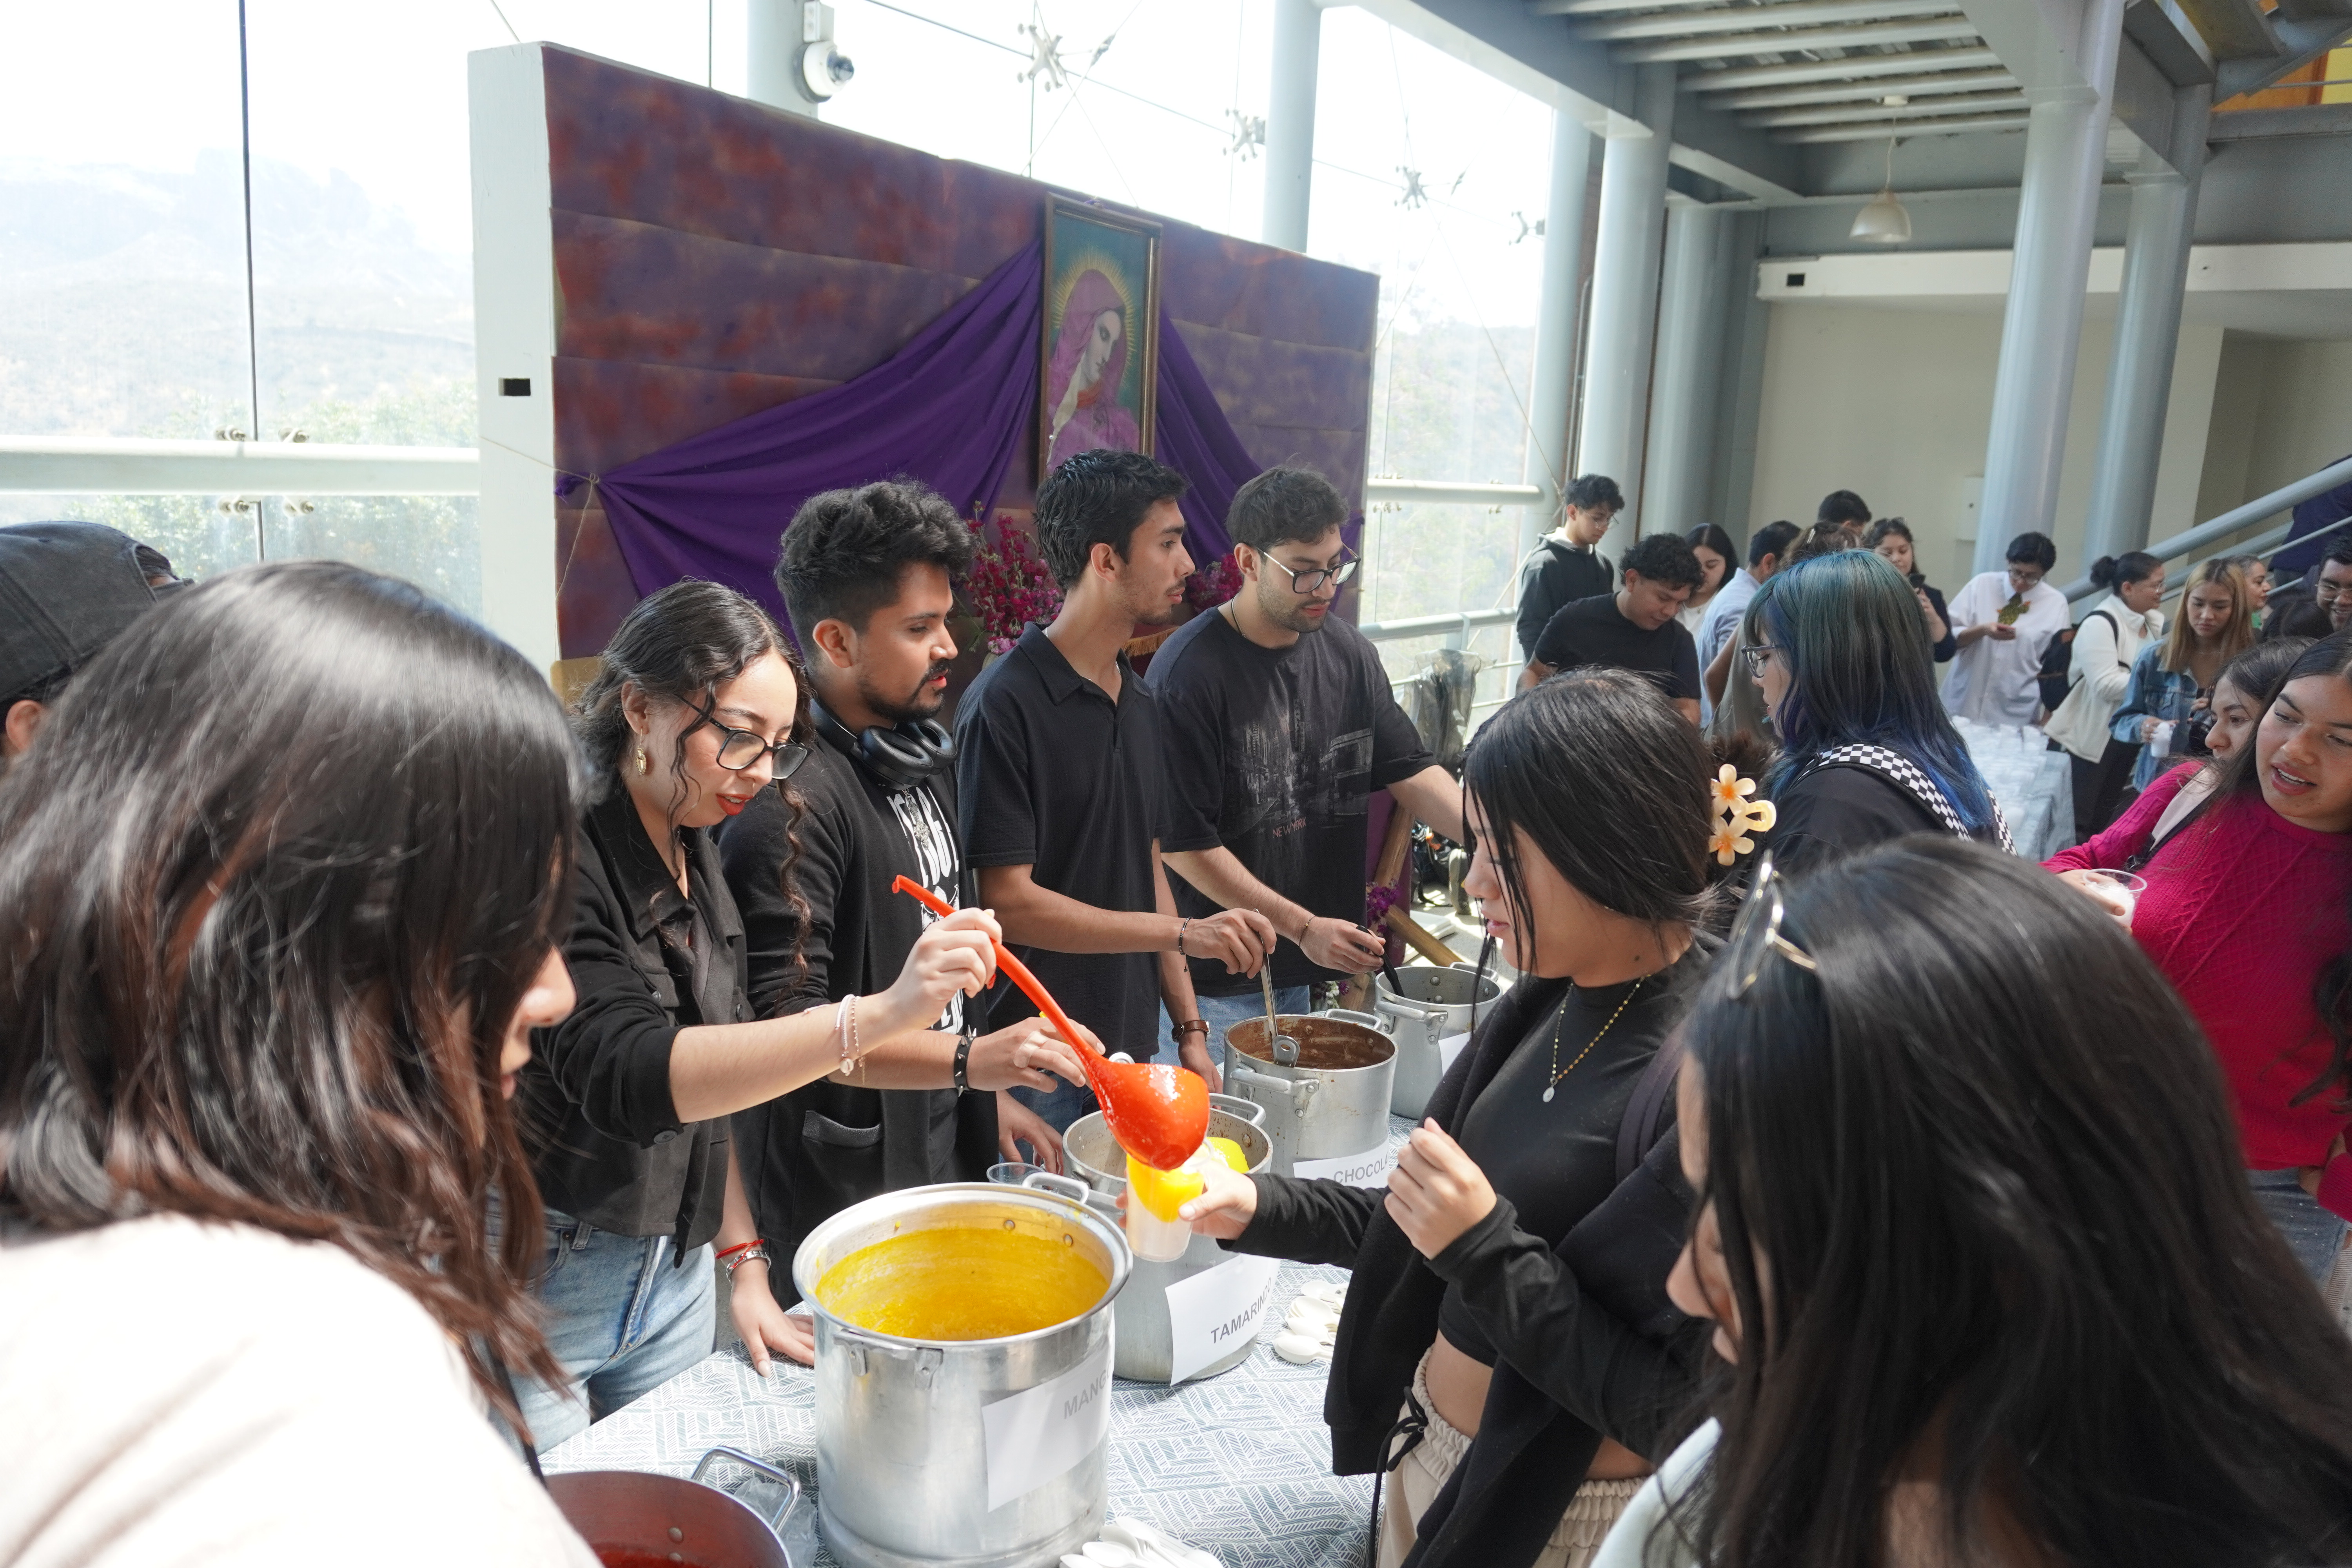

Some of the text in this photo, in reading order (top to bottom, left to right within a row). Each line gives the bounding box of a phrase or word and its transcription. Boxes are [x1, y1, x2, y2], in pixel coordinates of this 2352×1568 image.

[1273, 817, 1306, 838] NEW YORK
[1334, 1150, 1388, 1183] CHOCOLA
[1210, 1277, 1271, 1343] TAMARINDO
